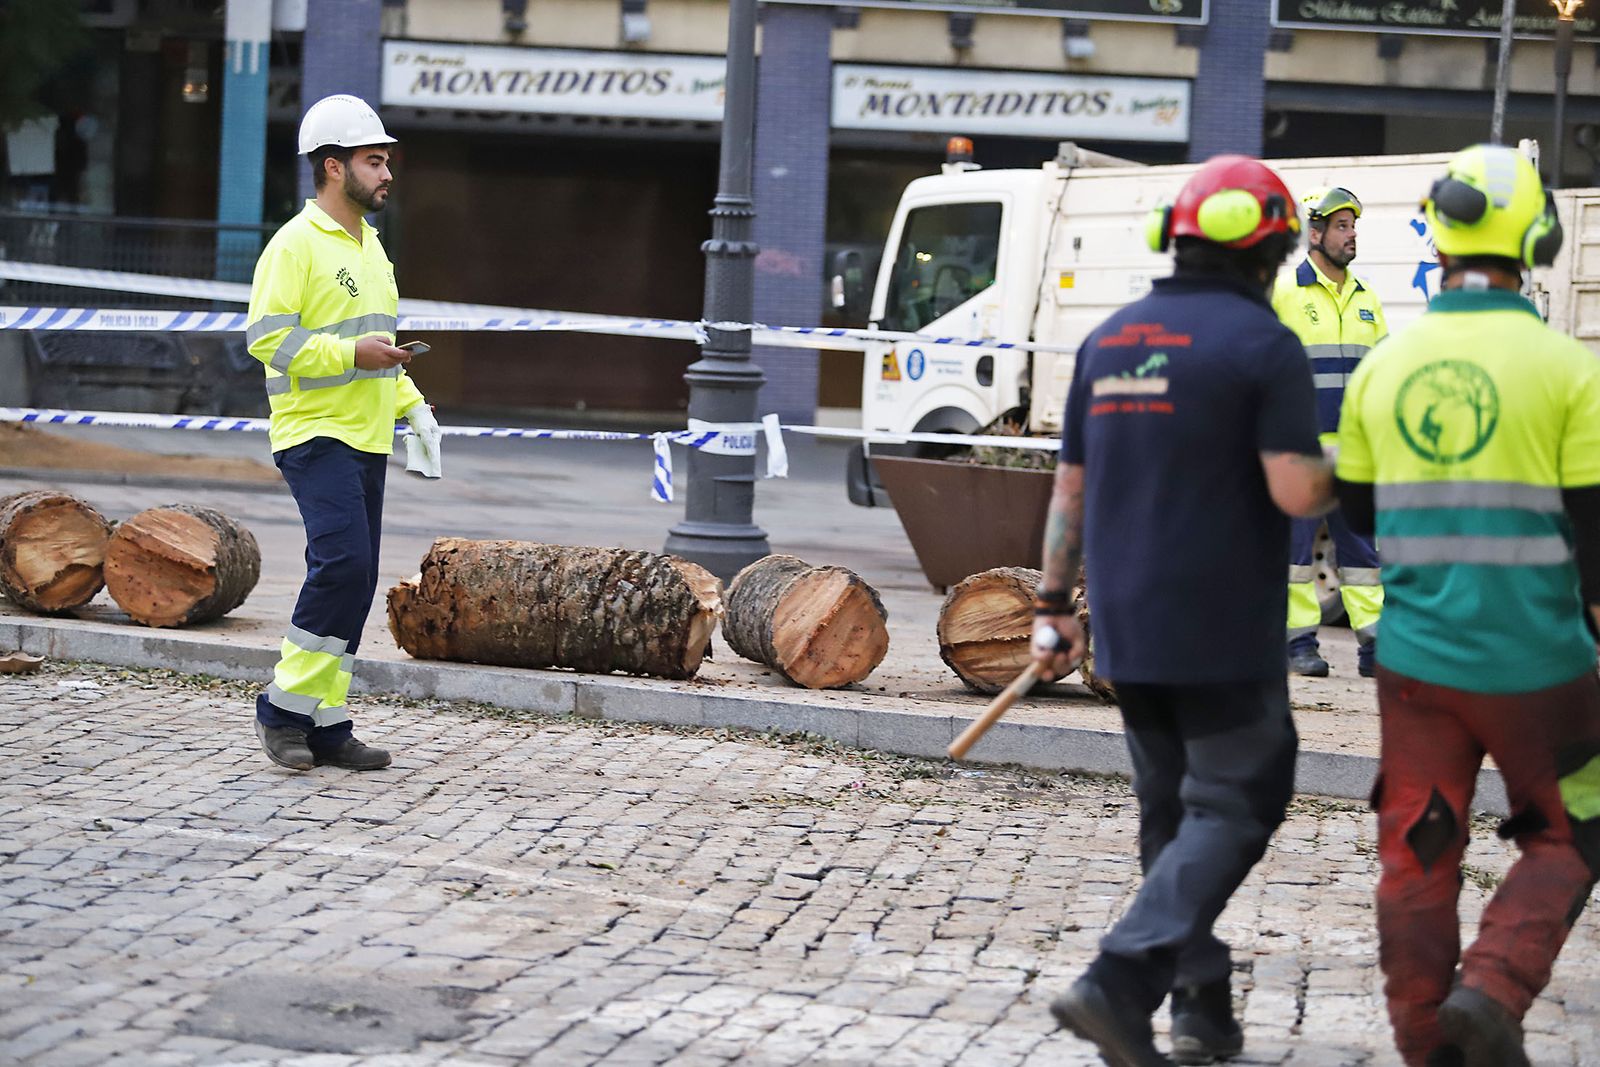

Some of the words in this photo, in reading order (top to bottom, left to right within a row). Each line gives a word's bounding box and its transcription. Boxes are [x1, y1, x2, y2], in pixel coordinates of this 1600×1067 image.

[411, 69, 672, 96] MONTADITOS
[861, 91, 1111, 117] MONTADITOS
[100, 314, 131, 327] POLICIA
[134, 315, 159, 328] LOCAL
